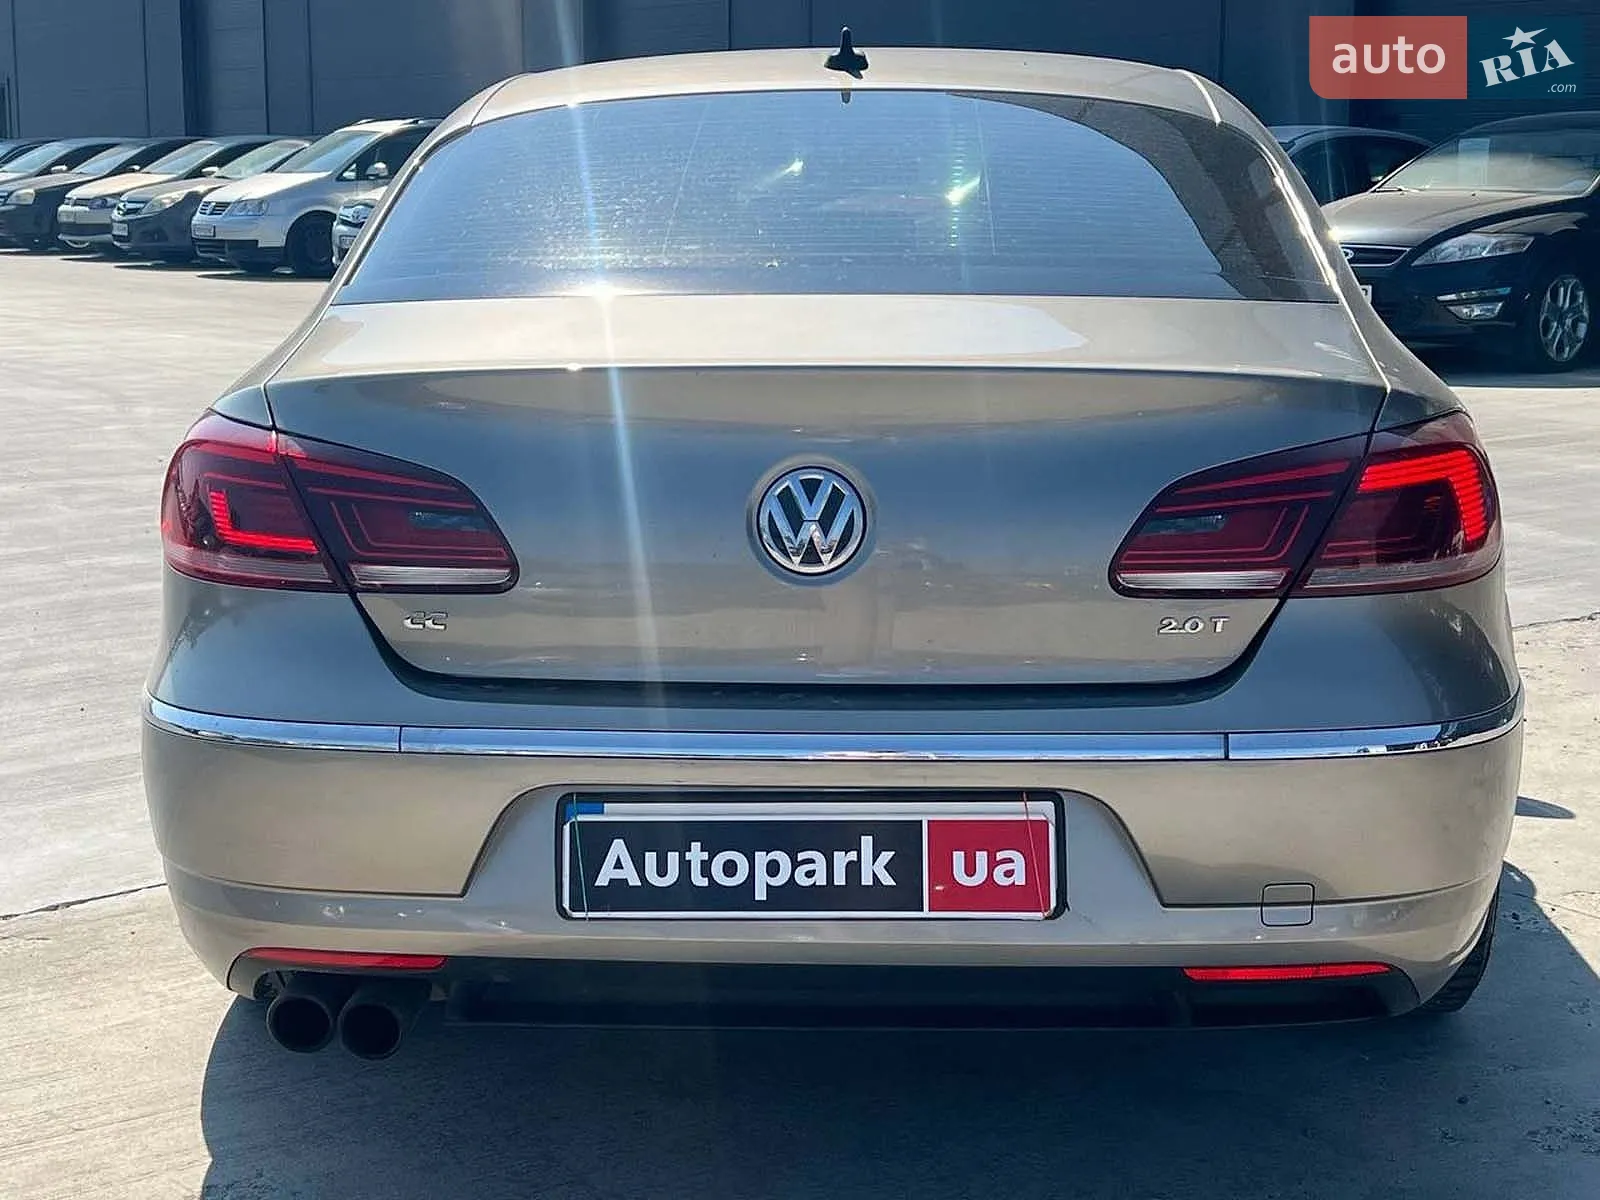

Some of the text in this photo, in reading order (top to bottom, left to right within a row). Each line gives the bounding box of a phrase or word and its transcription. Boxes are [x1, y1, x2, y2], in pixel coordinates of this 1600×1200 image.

[403, 611, 448, 631] CC
[1210, 616, 1231, 633] T
[594, 836, 1026, 900] Autopark ua
